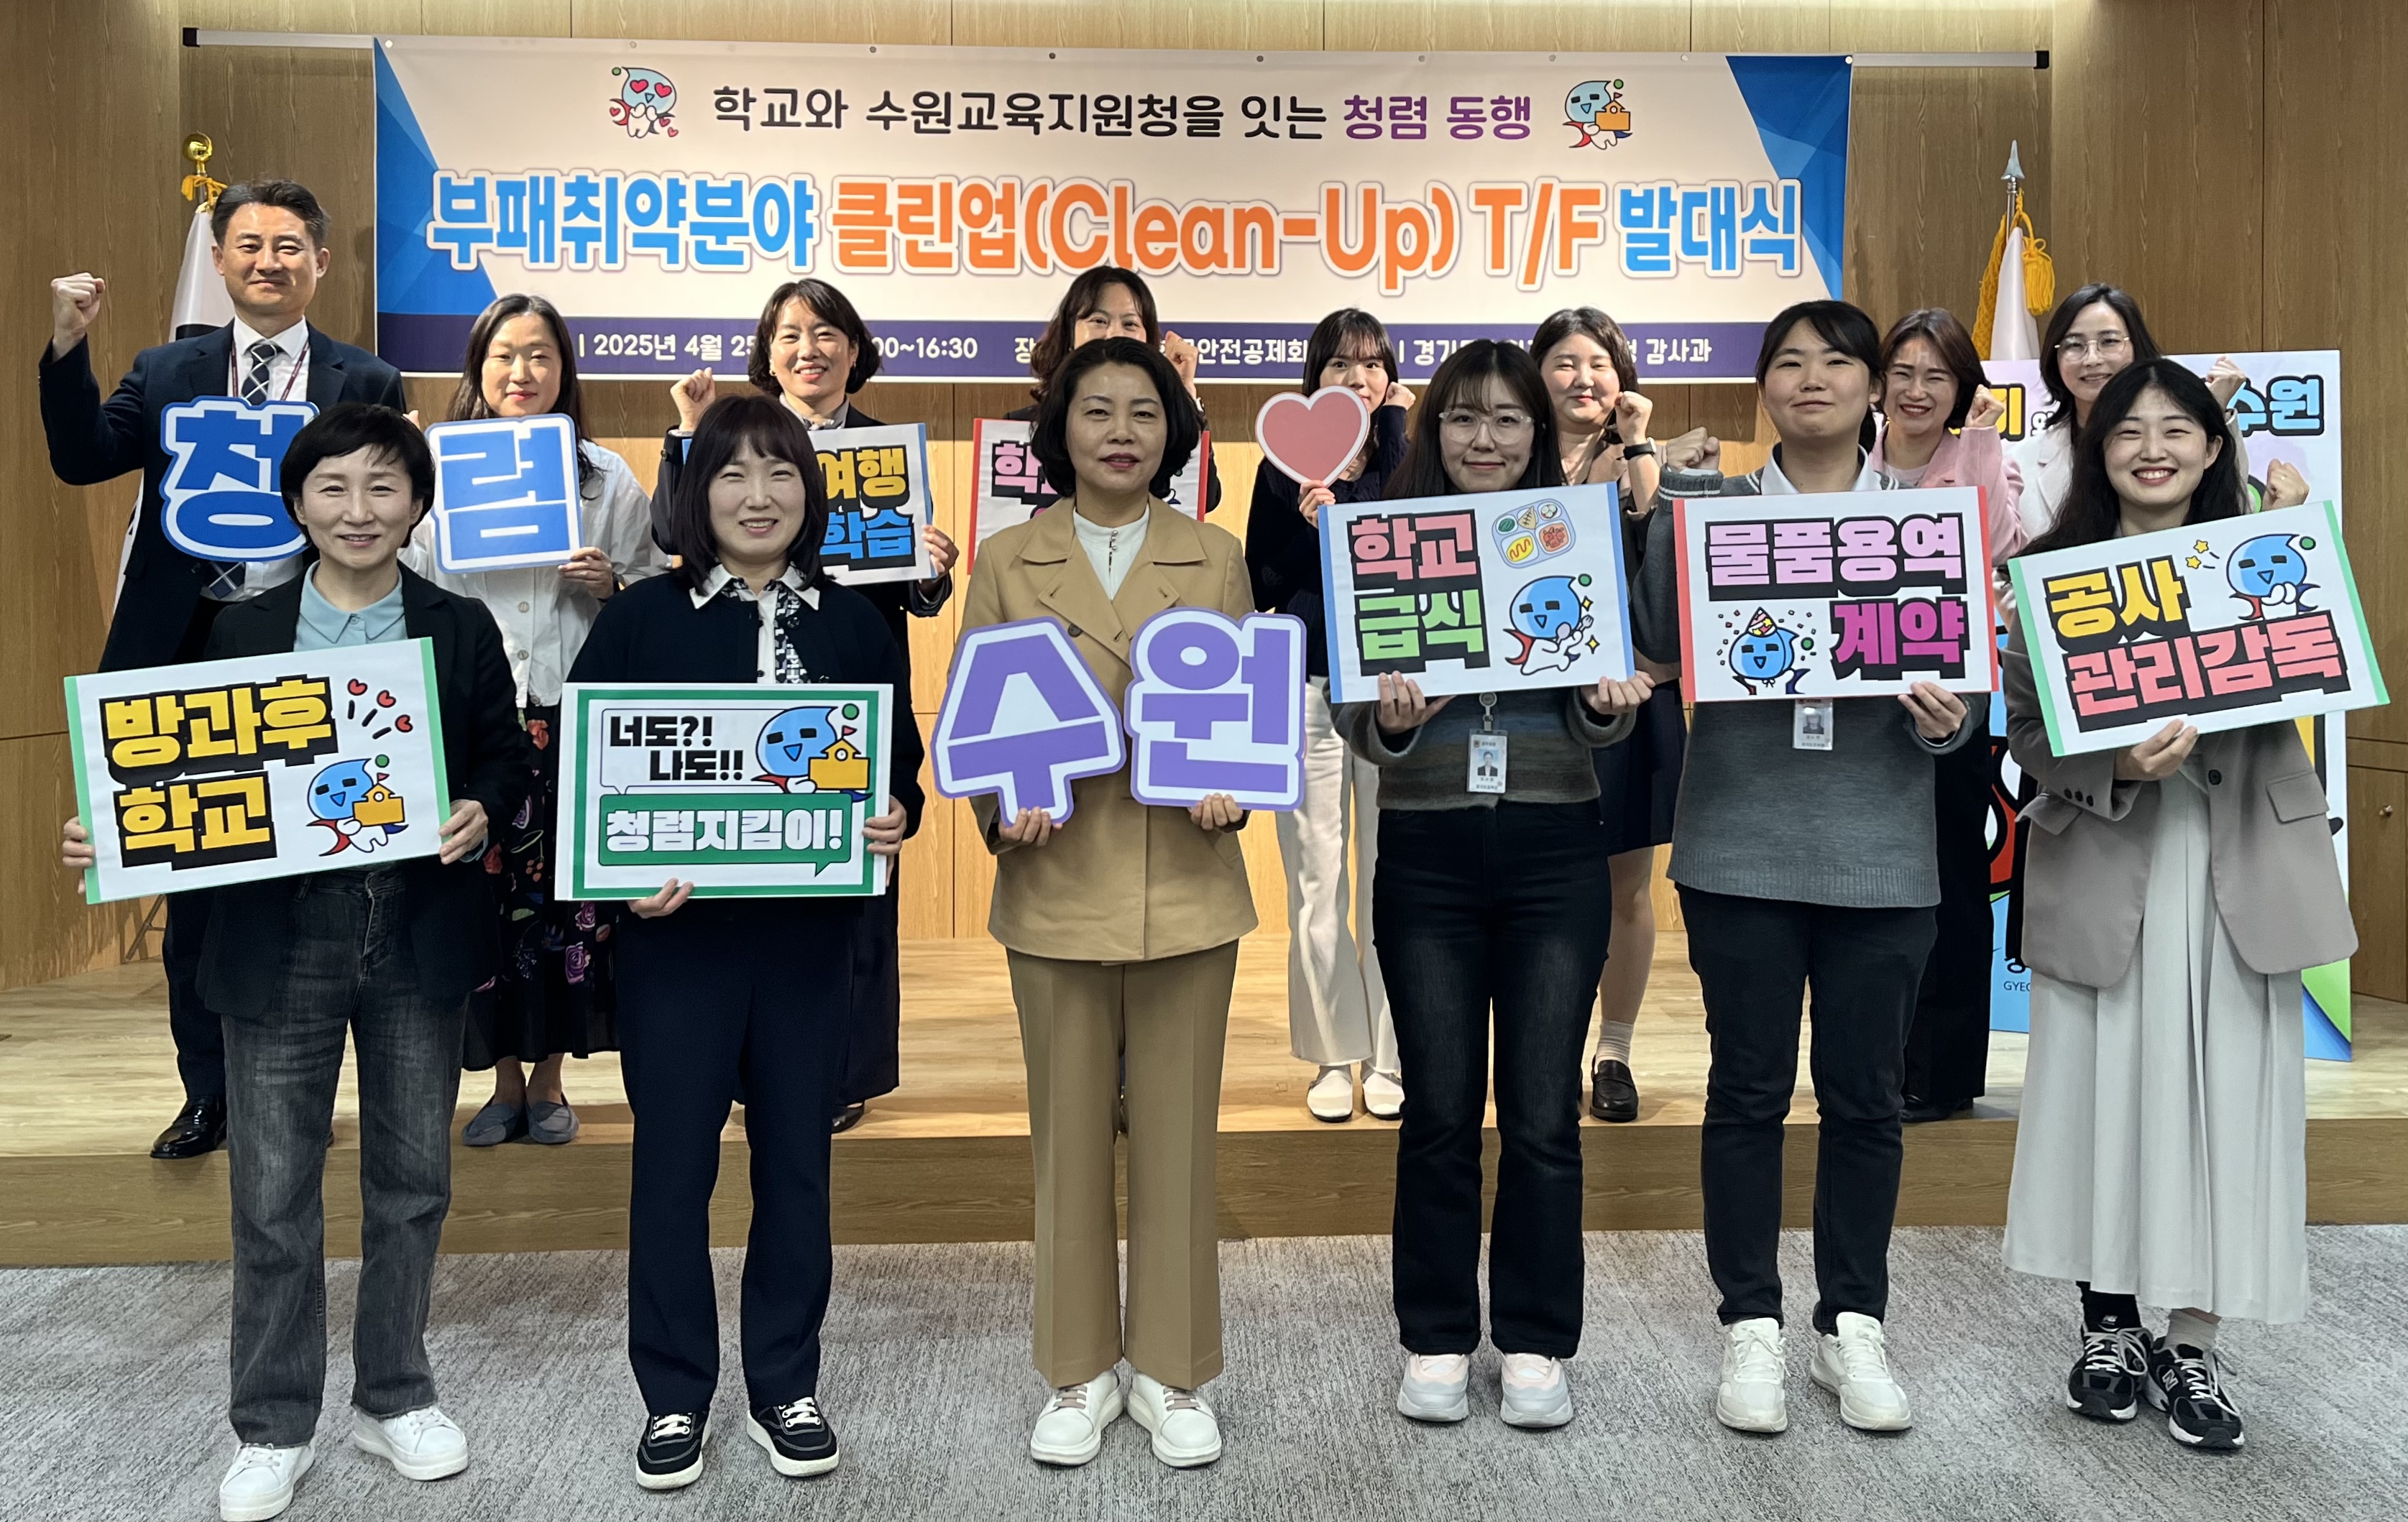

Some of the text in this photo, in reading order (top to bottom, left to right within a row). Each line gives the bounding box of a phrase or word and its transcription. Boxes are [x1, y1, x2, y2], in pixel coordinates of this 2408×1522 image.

[714, 86, 1531, 139] 학교와 수원교육지원청을 잇는 청렴 동행
[433, 175, 1796, 291] 부패취약분야 클린업(Clean-Up) T/F 발대식
[593, 333, 676, 361] 2025년
[684, 334, 722, 361] 4월
[1159, 338, 1308, 365] 안전공제회
[1645, 338, 1713, 365] 감사과
[175, 409, 307, 548] 청
[439, 425, 570, 561] 렴
[995, 443, 1058, 495] 학
[819, 506, 912, 560] 학습
[1351, 513, 1478, 581] 학교
[1709, 516, 1963, 586] 물품용역
[1359, 589, 1485, 660] 급식
[1834, 600, 1965, 665] 계약
[2047, 559, 2184, 639] 공사
[2067, 614, 2343, 717] 관리감독
[104, 678, 332, 768] 방과후
[609, 715, 713, 747] 너도?!
[947, 632, 1110, 809] 수
[1141, 621, 1291, 794] 원
[649, 749, 744, 782] 나도!!
[118, 775, 271, 854] 학교
[606, 808, 844, 853] 청렴지킴이!
